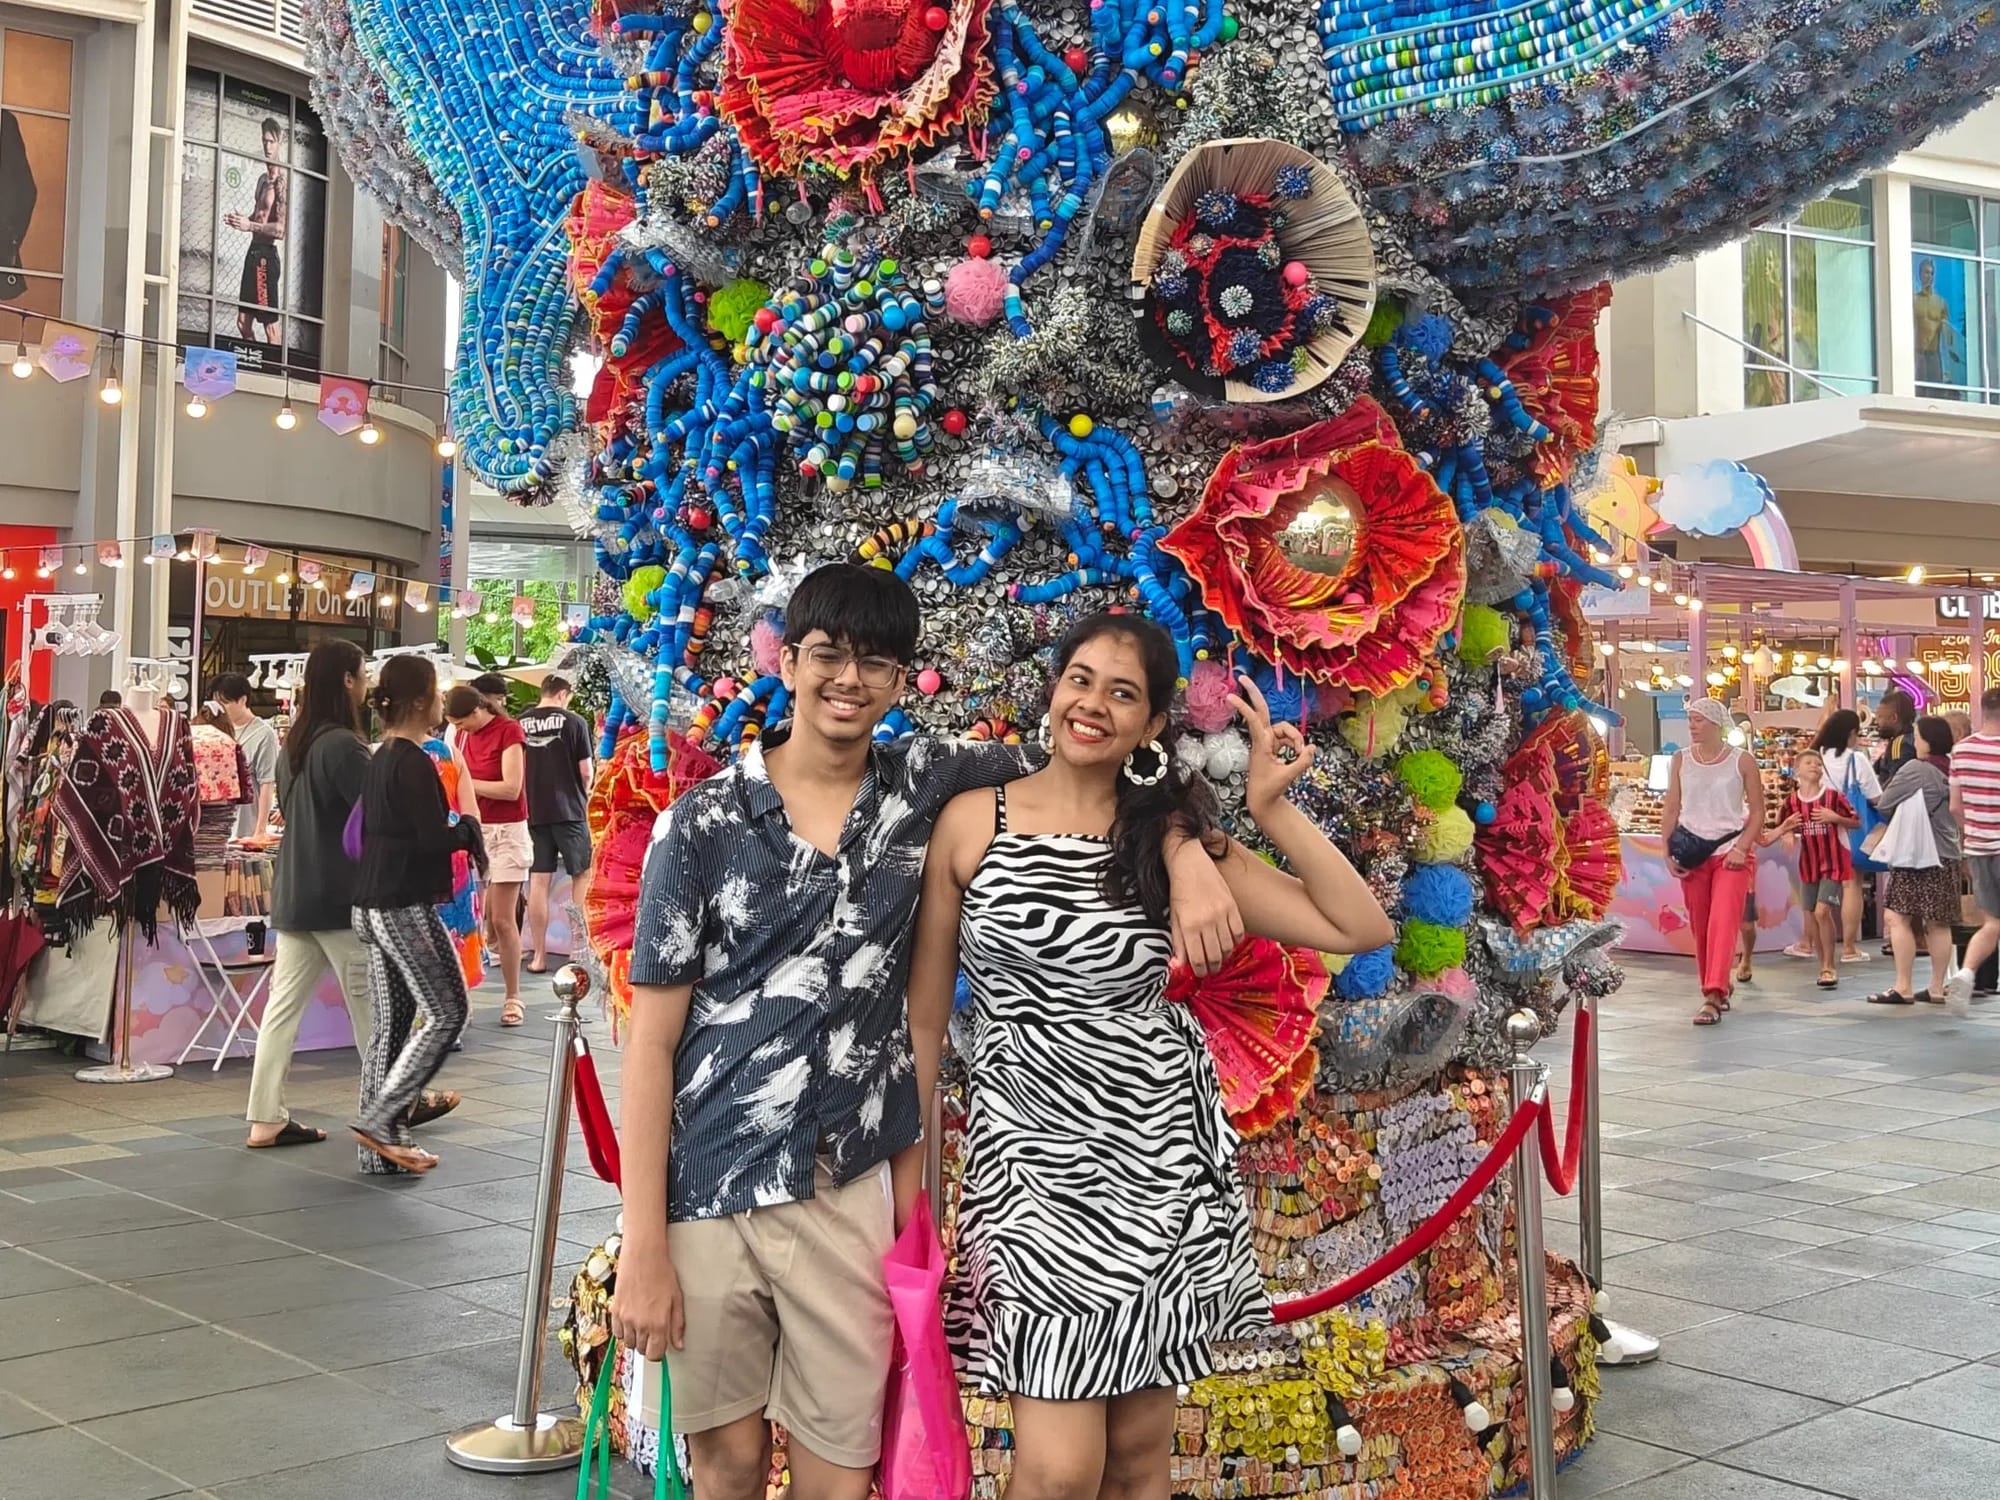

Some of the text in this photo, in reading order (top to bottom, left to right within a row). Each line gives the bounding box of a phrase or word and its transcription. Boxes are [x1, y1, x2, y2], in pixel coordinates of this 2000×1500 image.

[205, 576, 314, 612] OUTLET
[316, 587, 341, 615] On
[1940, 590, 2000, 619] CLB
